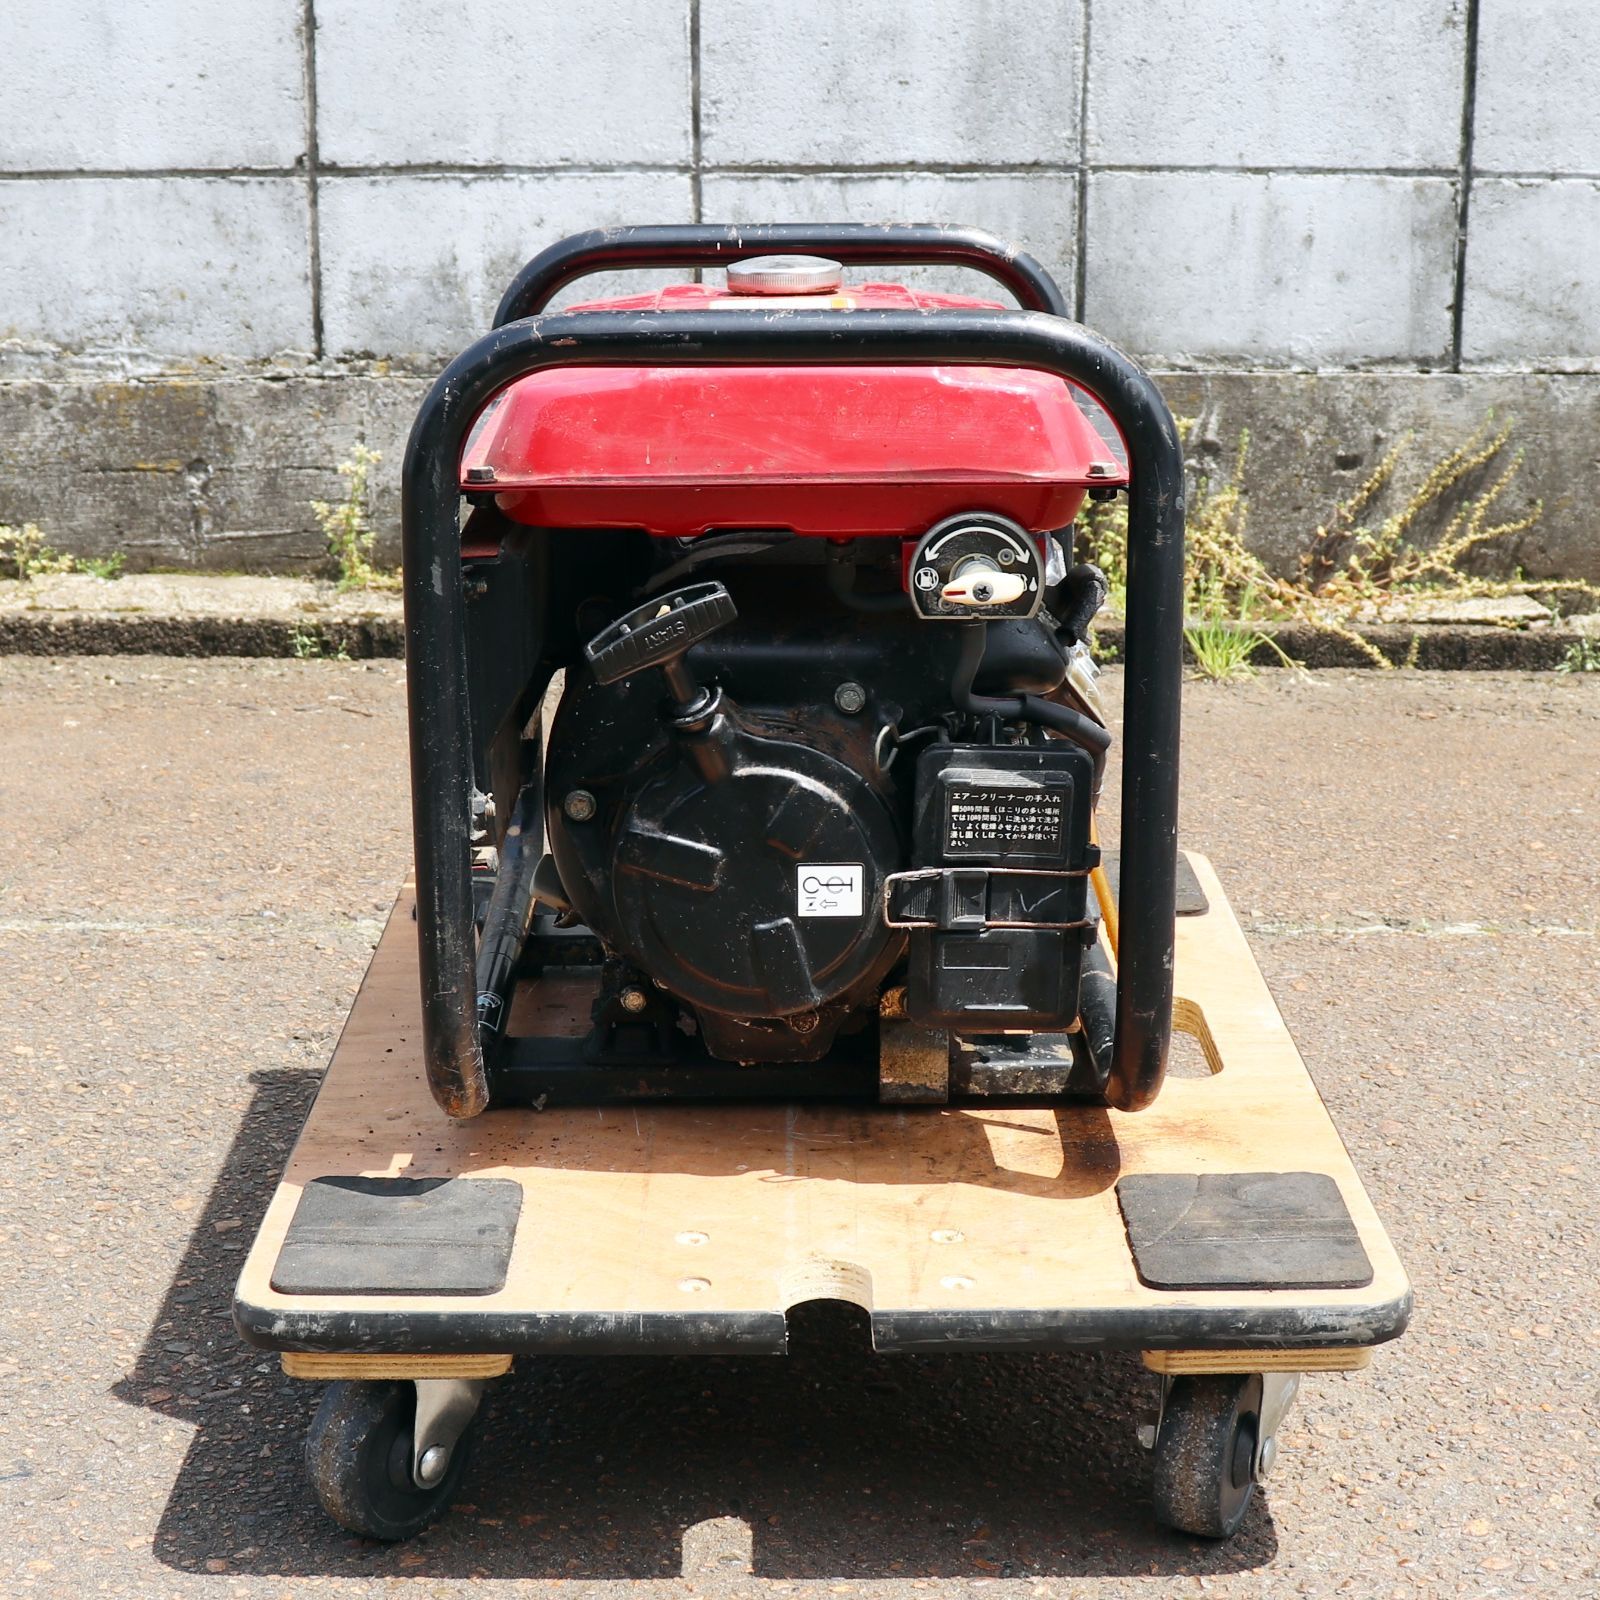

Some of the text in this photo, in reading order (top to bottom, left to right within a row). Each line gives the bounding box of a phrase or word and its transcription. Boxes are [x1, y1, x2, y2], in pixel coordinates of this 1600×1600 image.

[644, 620, 686, 649] START
[952, 792, 1061, 803] エアークリーナーの手入れ
